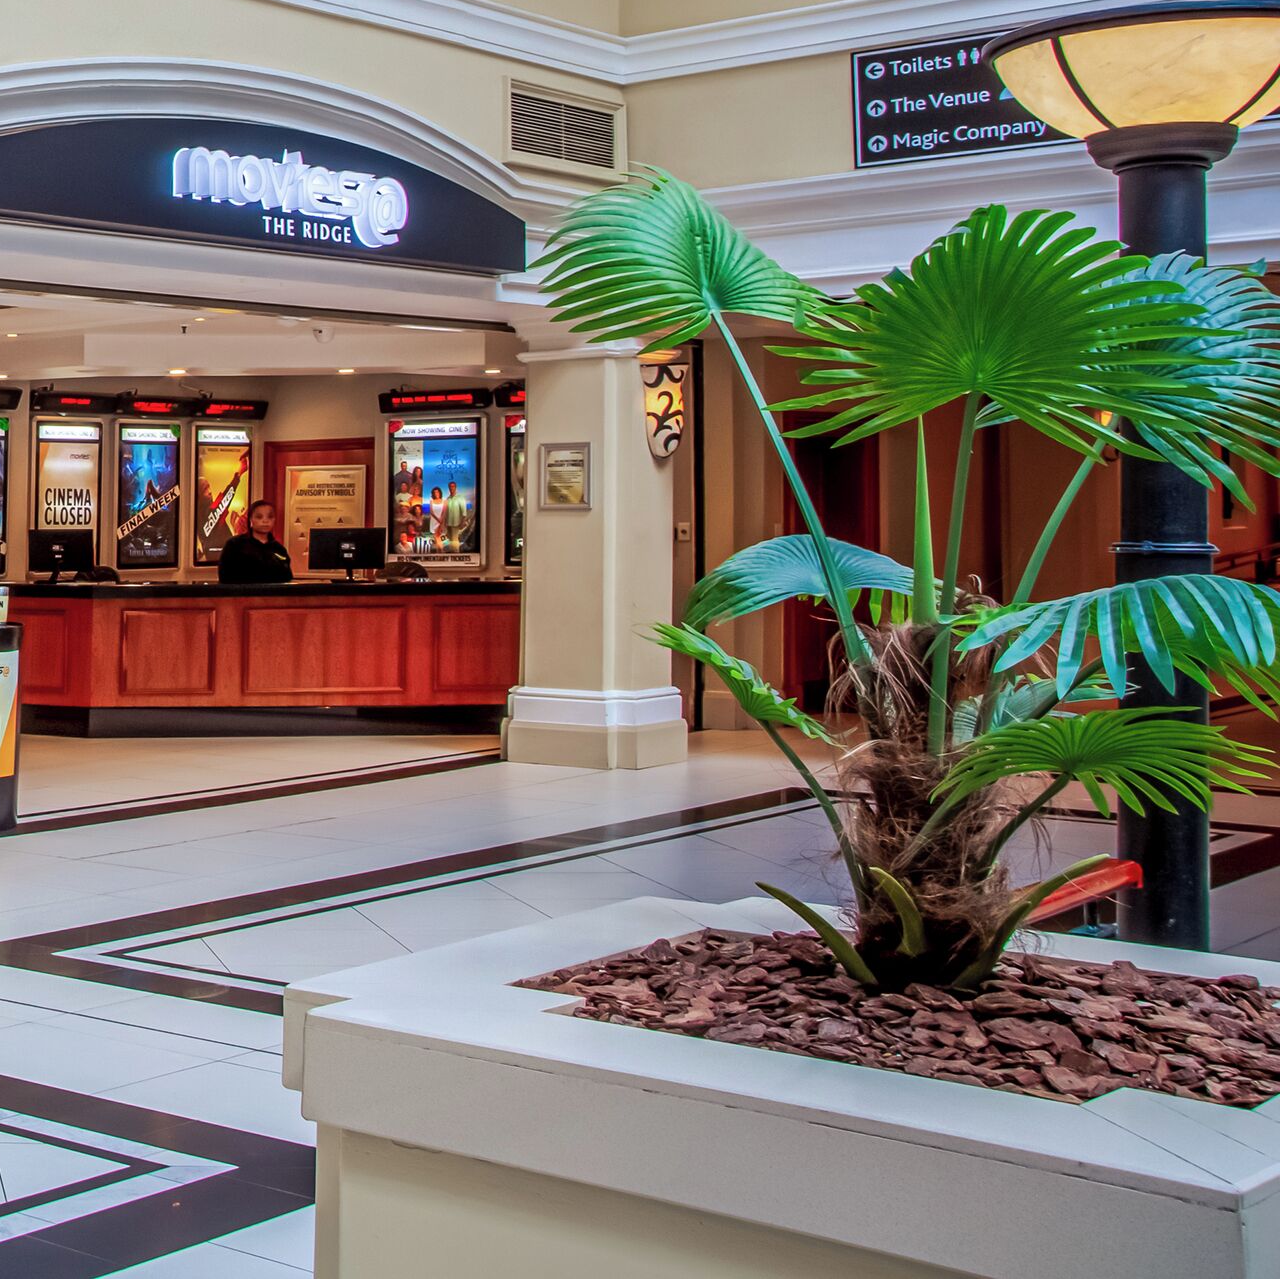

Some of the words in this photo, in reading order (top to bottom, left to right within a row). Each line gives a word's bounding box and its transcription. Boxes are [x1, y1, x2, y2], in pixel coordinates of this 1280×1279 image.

[889, 55, 952, 76] Toilets
[891, 96, 926, 114] The
[928, 90, 991, 109] Venue
[893, 129, 950, 150] Magic
[954, 120, 1047, 141] Company
[173, 146, 409, 248] movies@
[262, 215, 296, 237] THE
[302, 221, 352, 244] RIDGE
[417, 426, 446, 434] SHOWING
[45, 488, 92, 507] CINEMA
[296, 489, 326, 497] ADVISORY
[327, 488, 356, 497] SYMBOLS
[44, 507, 92, 526] CLOSED
[120, 513, 148, 536] FINAL
[149, 488, 178, 514] WEEK
